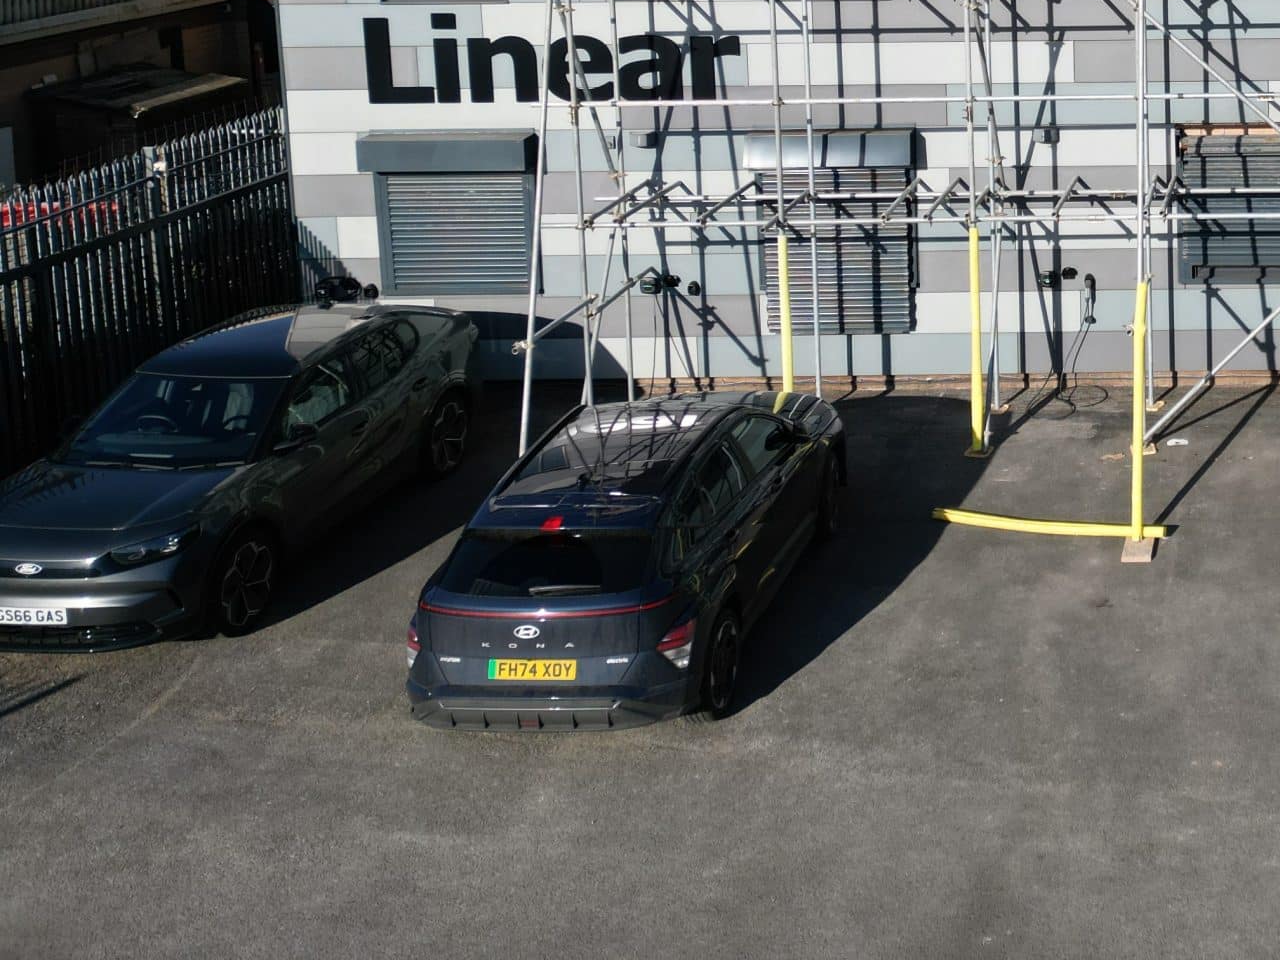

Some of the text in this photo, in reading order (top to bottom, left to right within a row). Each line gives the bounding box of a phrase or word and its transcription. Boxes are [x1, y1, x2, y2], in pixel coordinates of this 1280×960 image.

[361, 12, 740, 104] Linear
[36, 610, 64, 622] GAS
[498, 662, 573, 678] FH74 XOY
